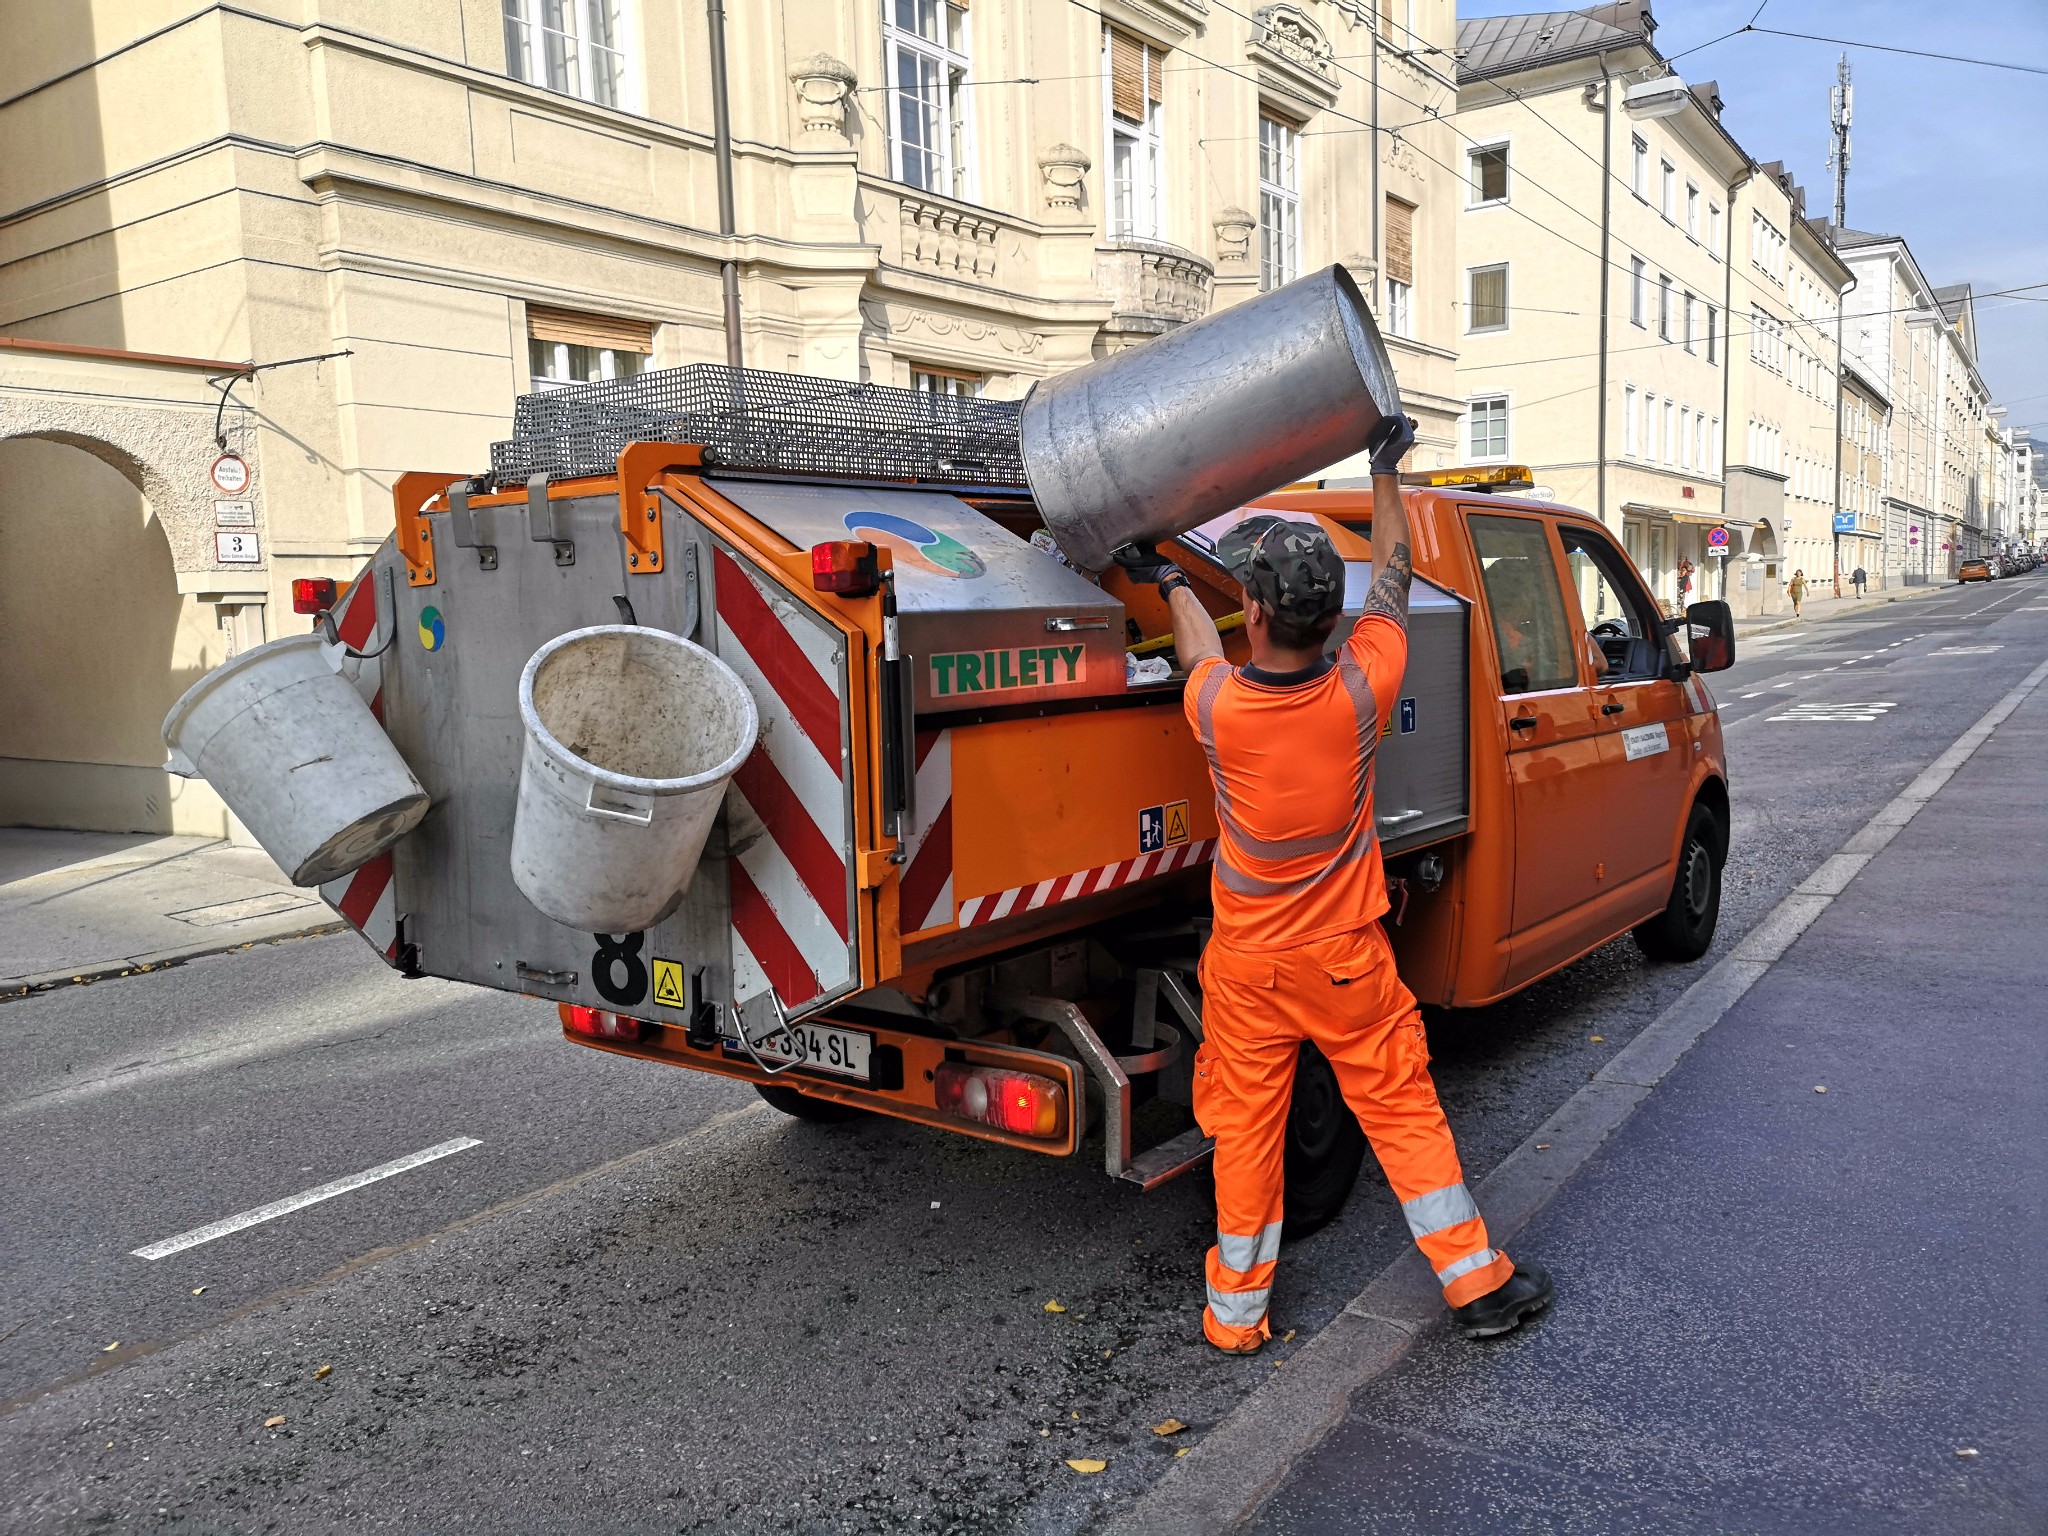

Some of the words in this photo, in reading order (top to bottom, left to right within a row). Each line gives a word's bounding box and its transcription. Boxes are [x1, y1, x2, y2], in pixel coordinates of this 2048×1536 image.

[218, 474, 242, 482] freihalten
[232, 536, 243, 552] 3
[931, 645, 1083, 695] TRILETY
[592, 930, 648, 1006] 8
[828, 1034, 856, 1069] SL
